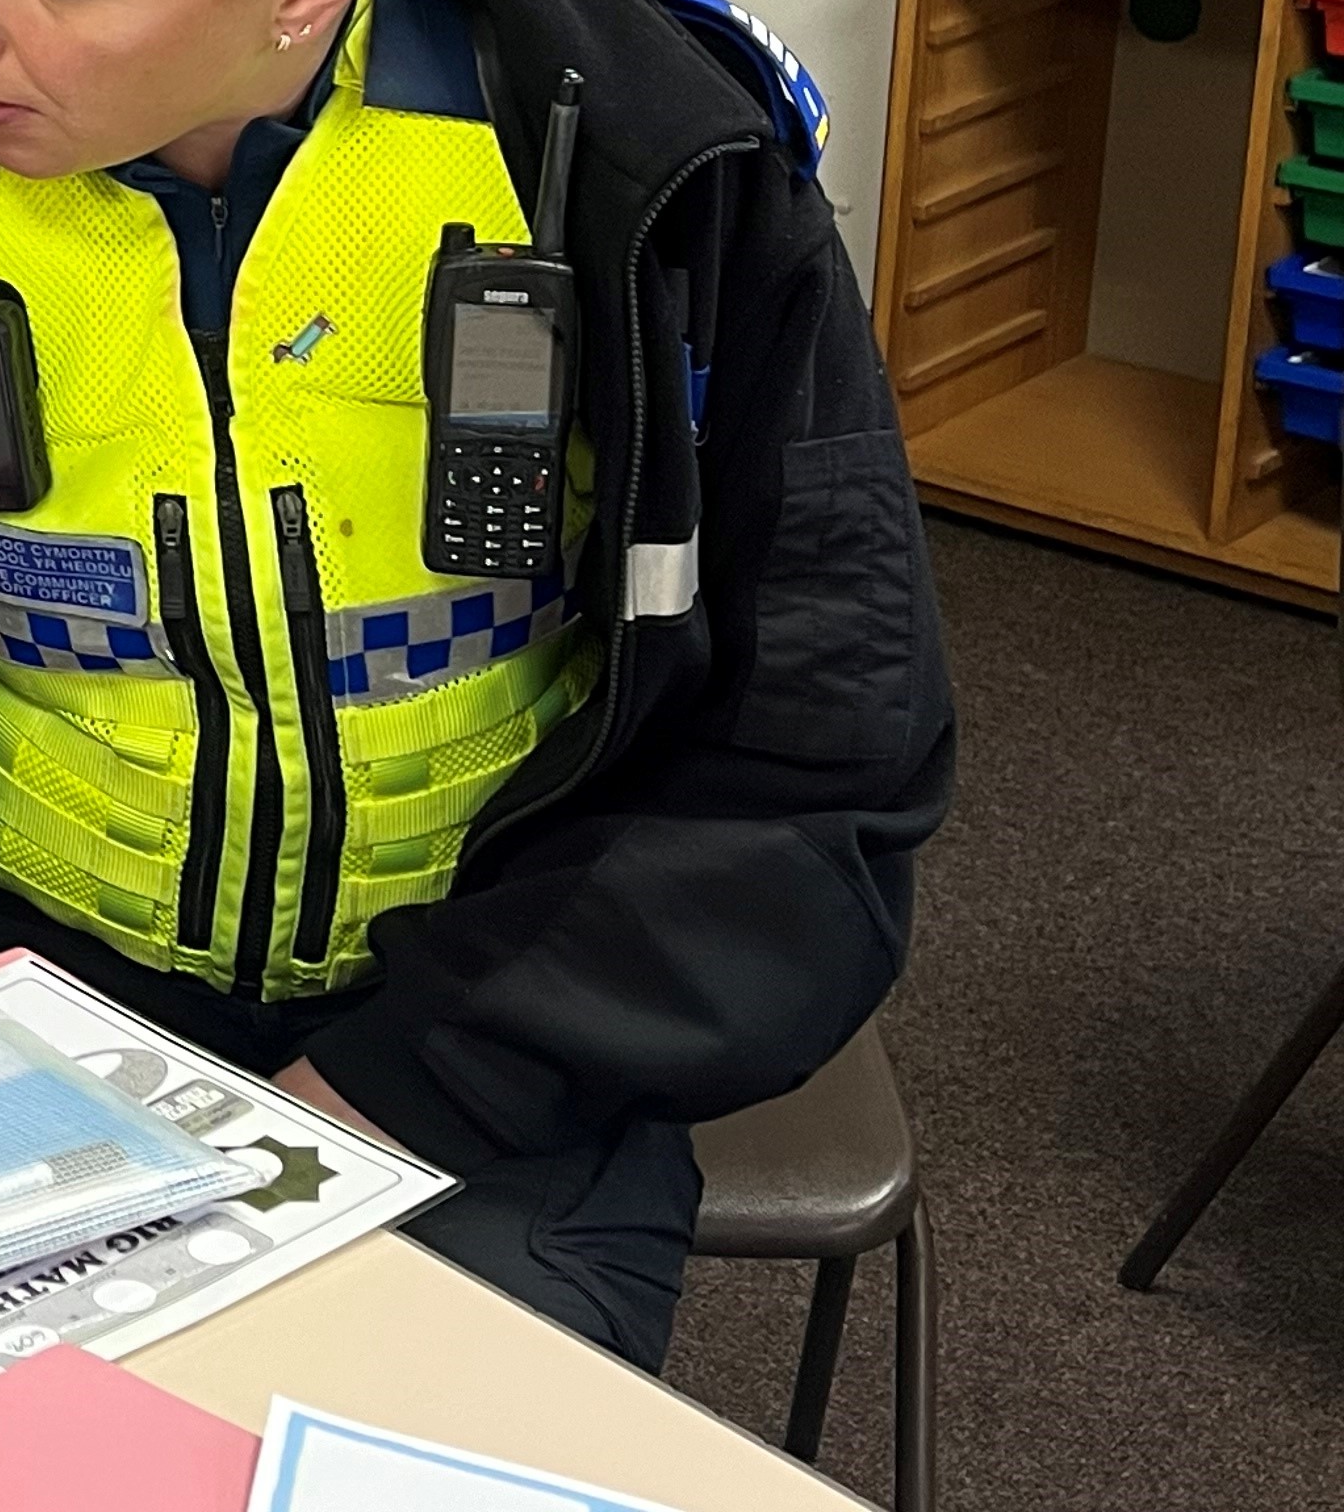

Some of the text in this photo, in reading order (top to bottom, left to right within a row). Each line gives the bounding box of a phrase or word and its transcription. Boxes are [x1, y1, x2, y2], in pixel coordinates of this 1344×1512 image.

[30, 544, 116, 563] CYMORTH
[33, 556, 58, 571] YR
[63, 559, 132, 578] HEDDLU
[14, 572, 116, 596] COMMUNITY
[39, 587, 112, 607] OFFICER
